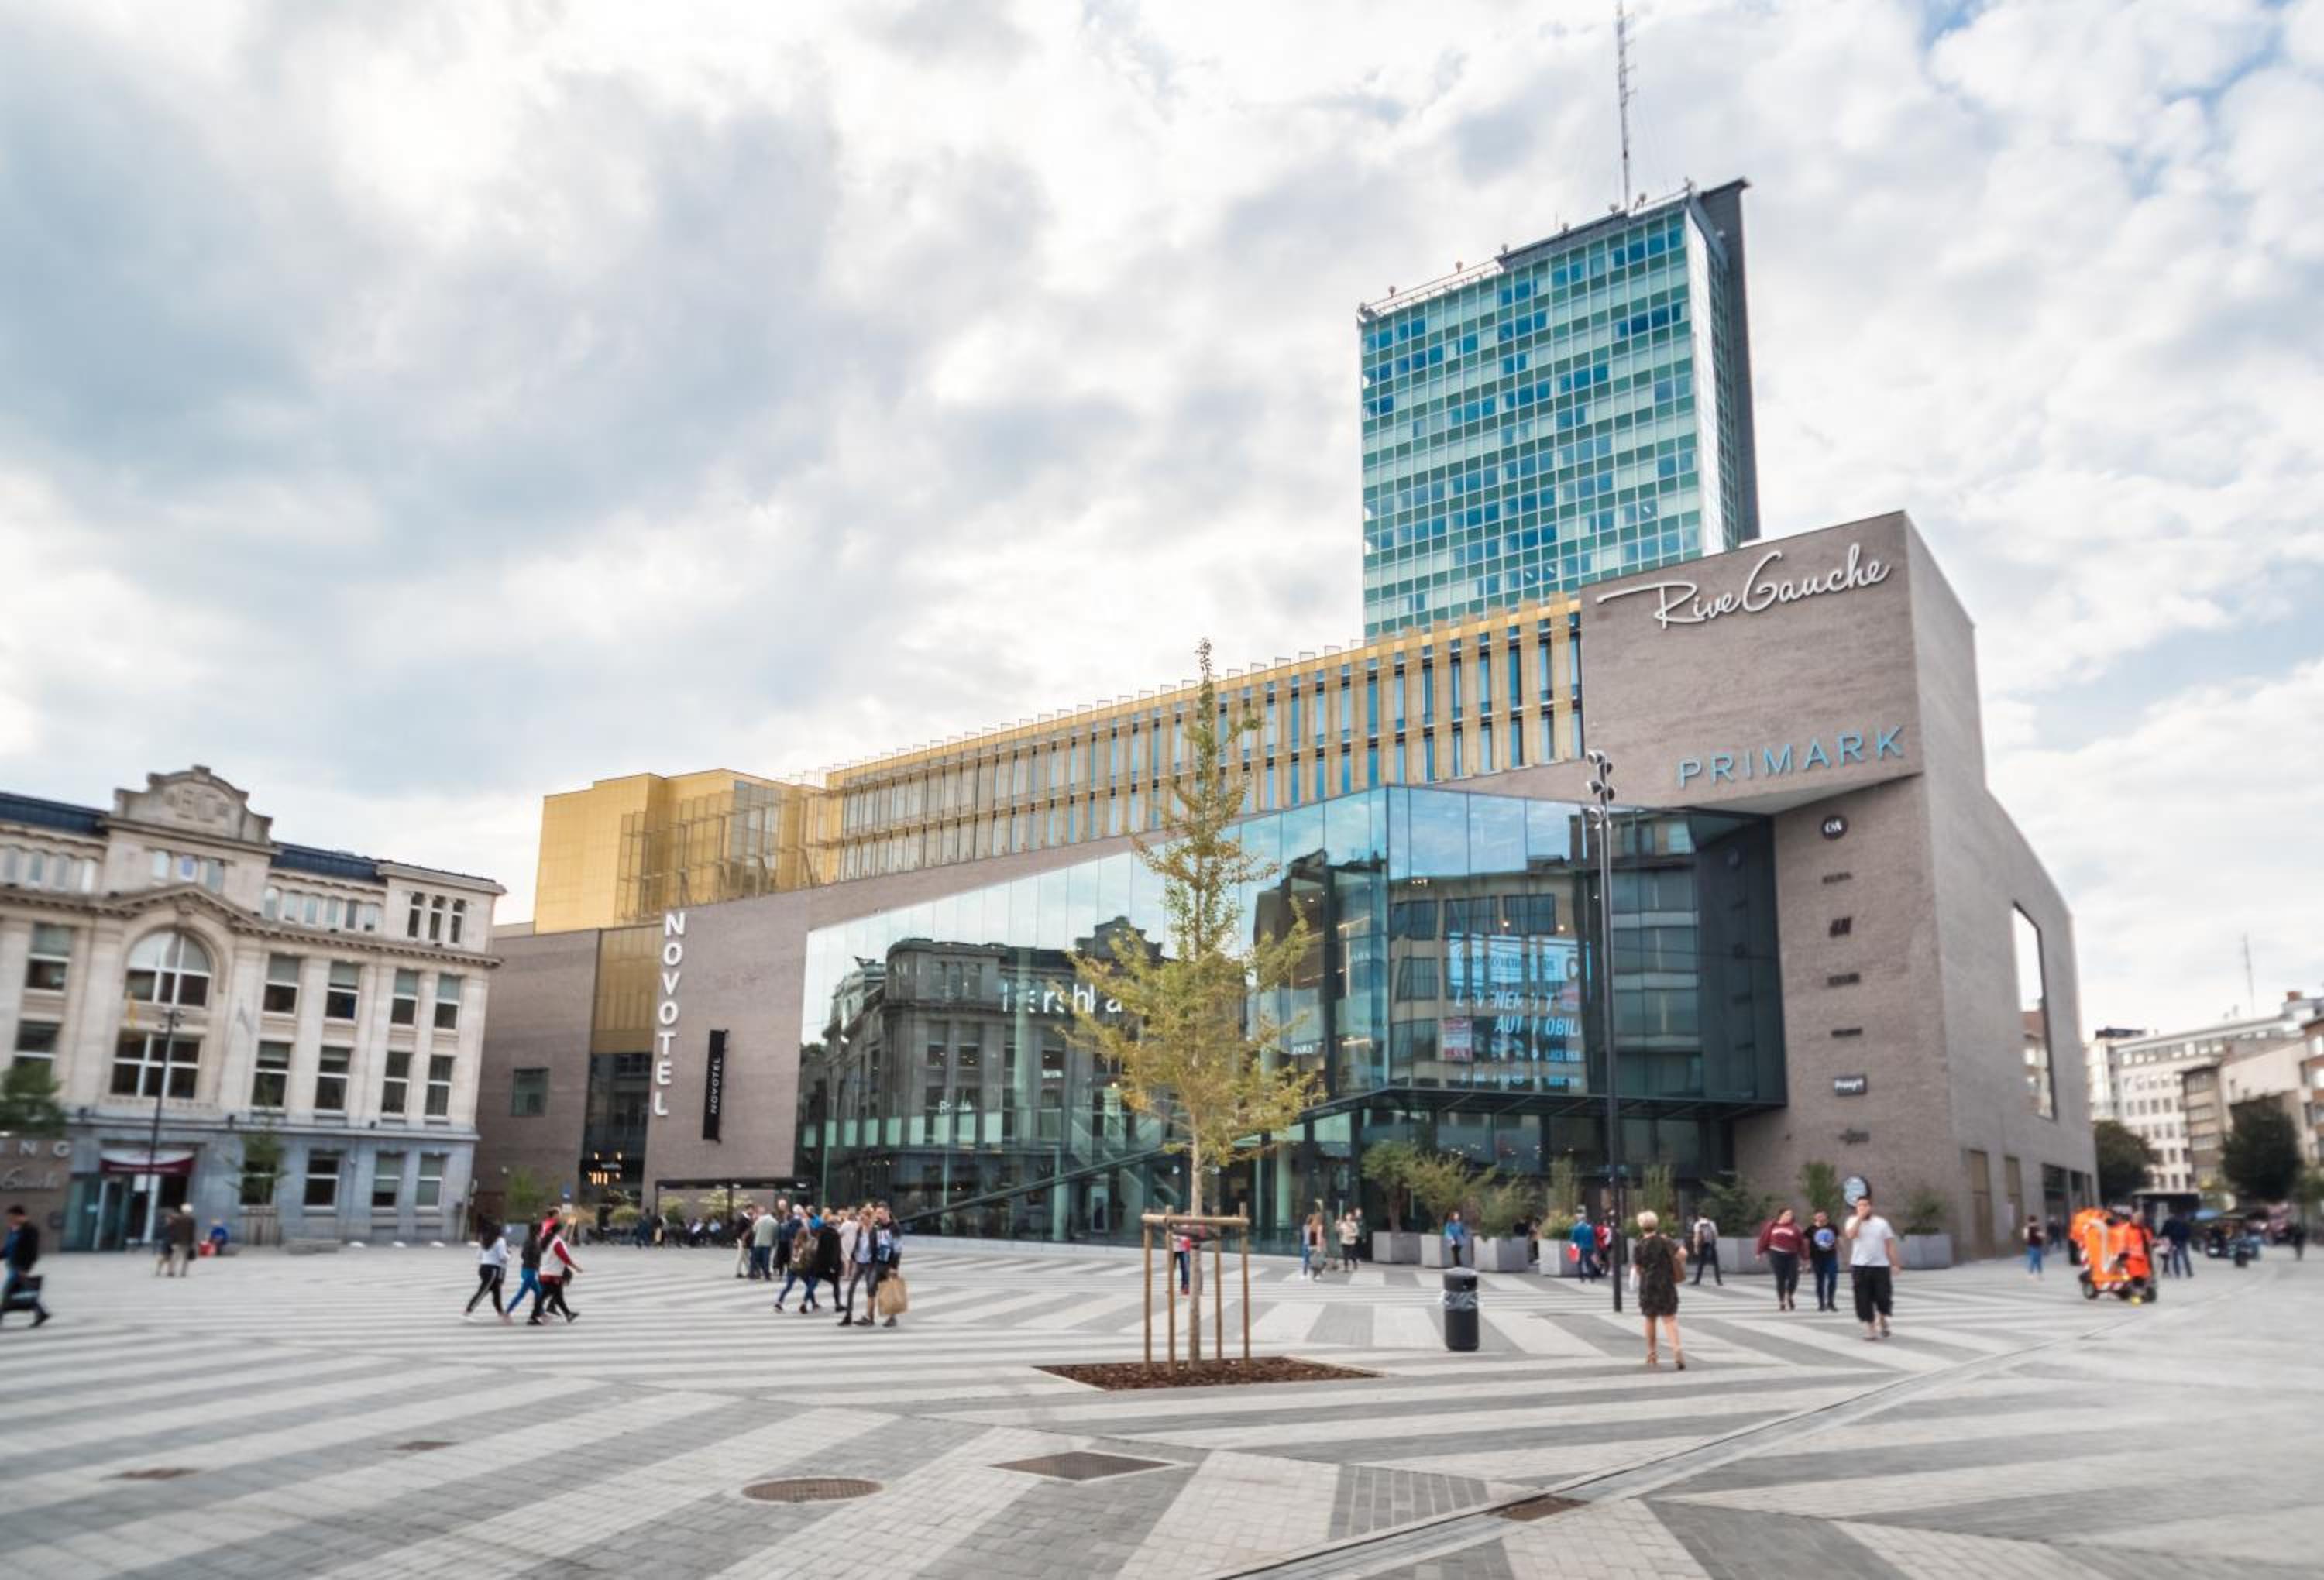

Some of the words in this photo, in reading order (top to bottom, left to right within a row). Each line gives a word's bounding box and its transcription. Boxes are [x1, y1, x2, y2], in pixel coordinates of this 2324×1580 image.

[1597, 579, 1744, 630] Rive
[1742, 542, 1891, 613] Gauche
[1677, 724, 1906, 788] PRIMARK
[654, 912, 686, 1116] NOVOTEL
[710, 1057, 721, 1114] NOVOTEL
